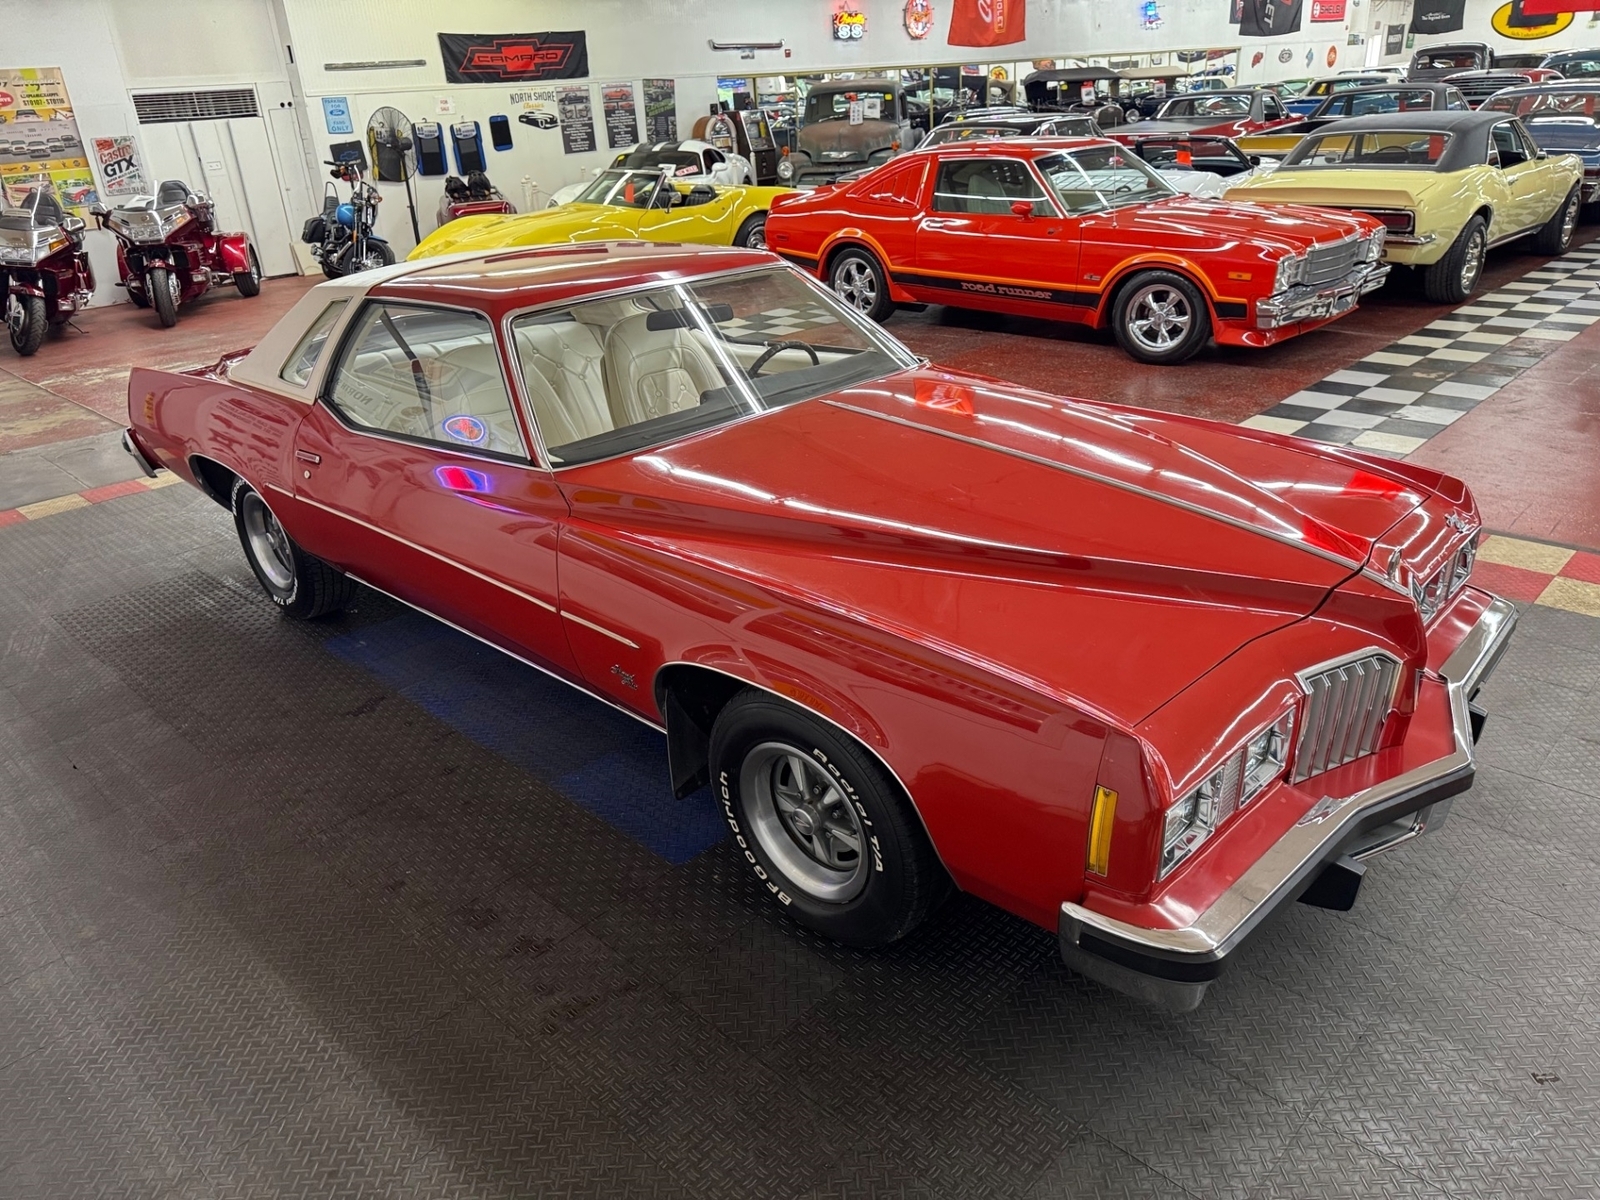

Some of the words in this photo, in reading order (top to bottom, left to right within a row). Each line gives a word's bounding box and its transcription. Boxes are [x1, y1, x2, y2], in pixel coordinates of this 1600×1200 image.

[1320, 4, 1344, 14] SHELBY
[838, 24, 863, 38] SS
[477, 52, 558, 63] CAMARO
[510, 91, 532, 105] NORTH
[533, 90, 556, 103] SHORE
[100, 144, 134, 165] Castro
[104, 154, 137, 177] GTX
[961, 281, 996, 293] road
[998, 286, 1053, 299] runner
[813, 749, 873, 827] Radial
[870, 835, 884, 873] T/A
[718, 771, 792, 906] BFGoodrich
